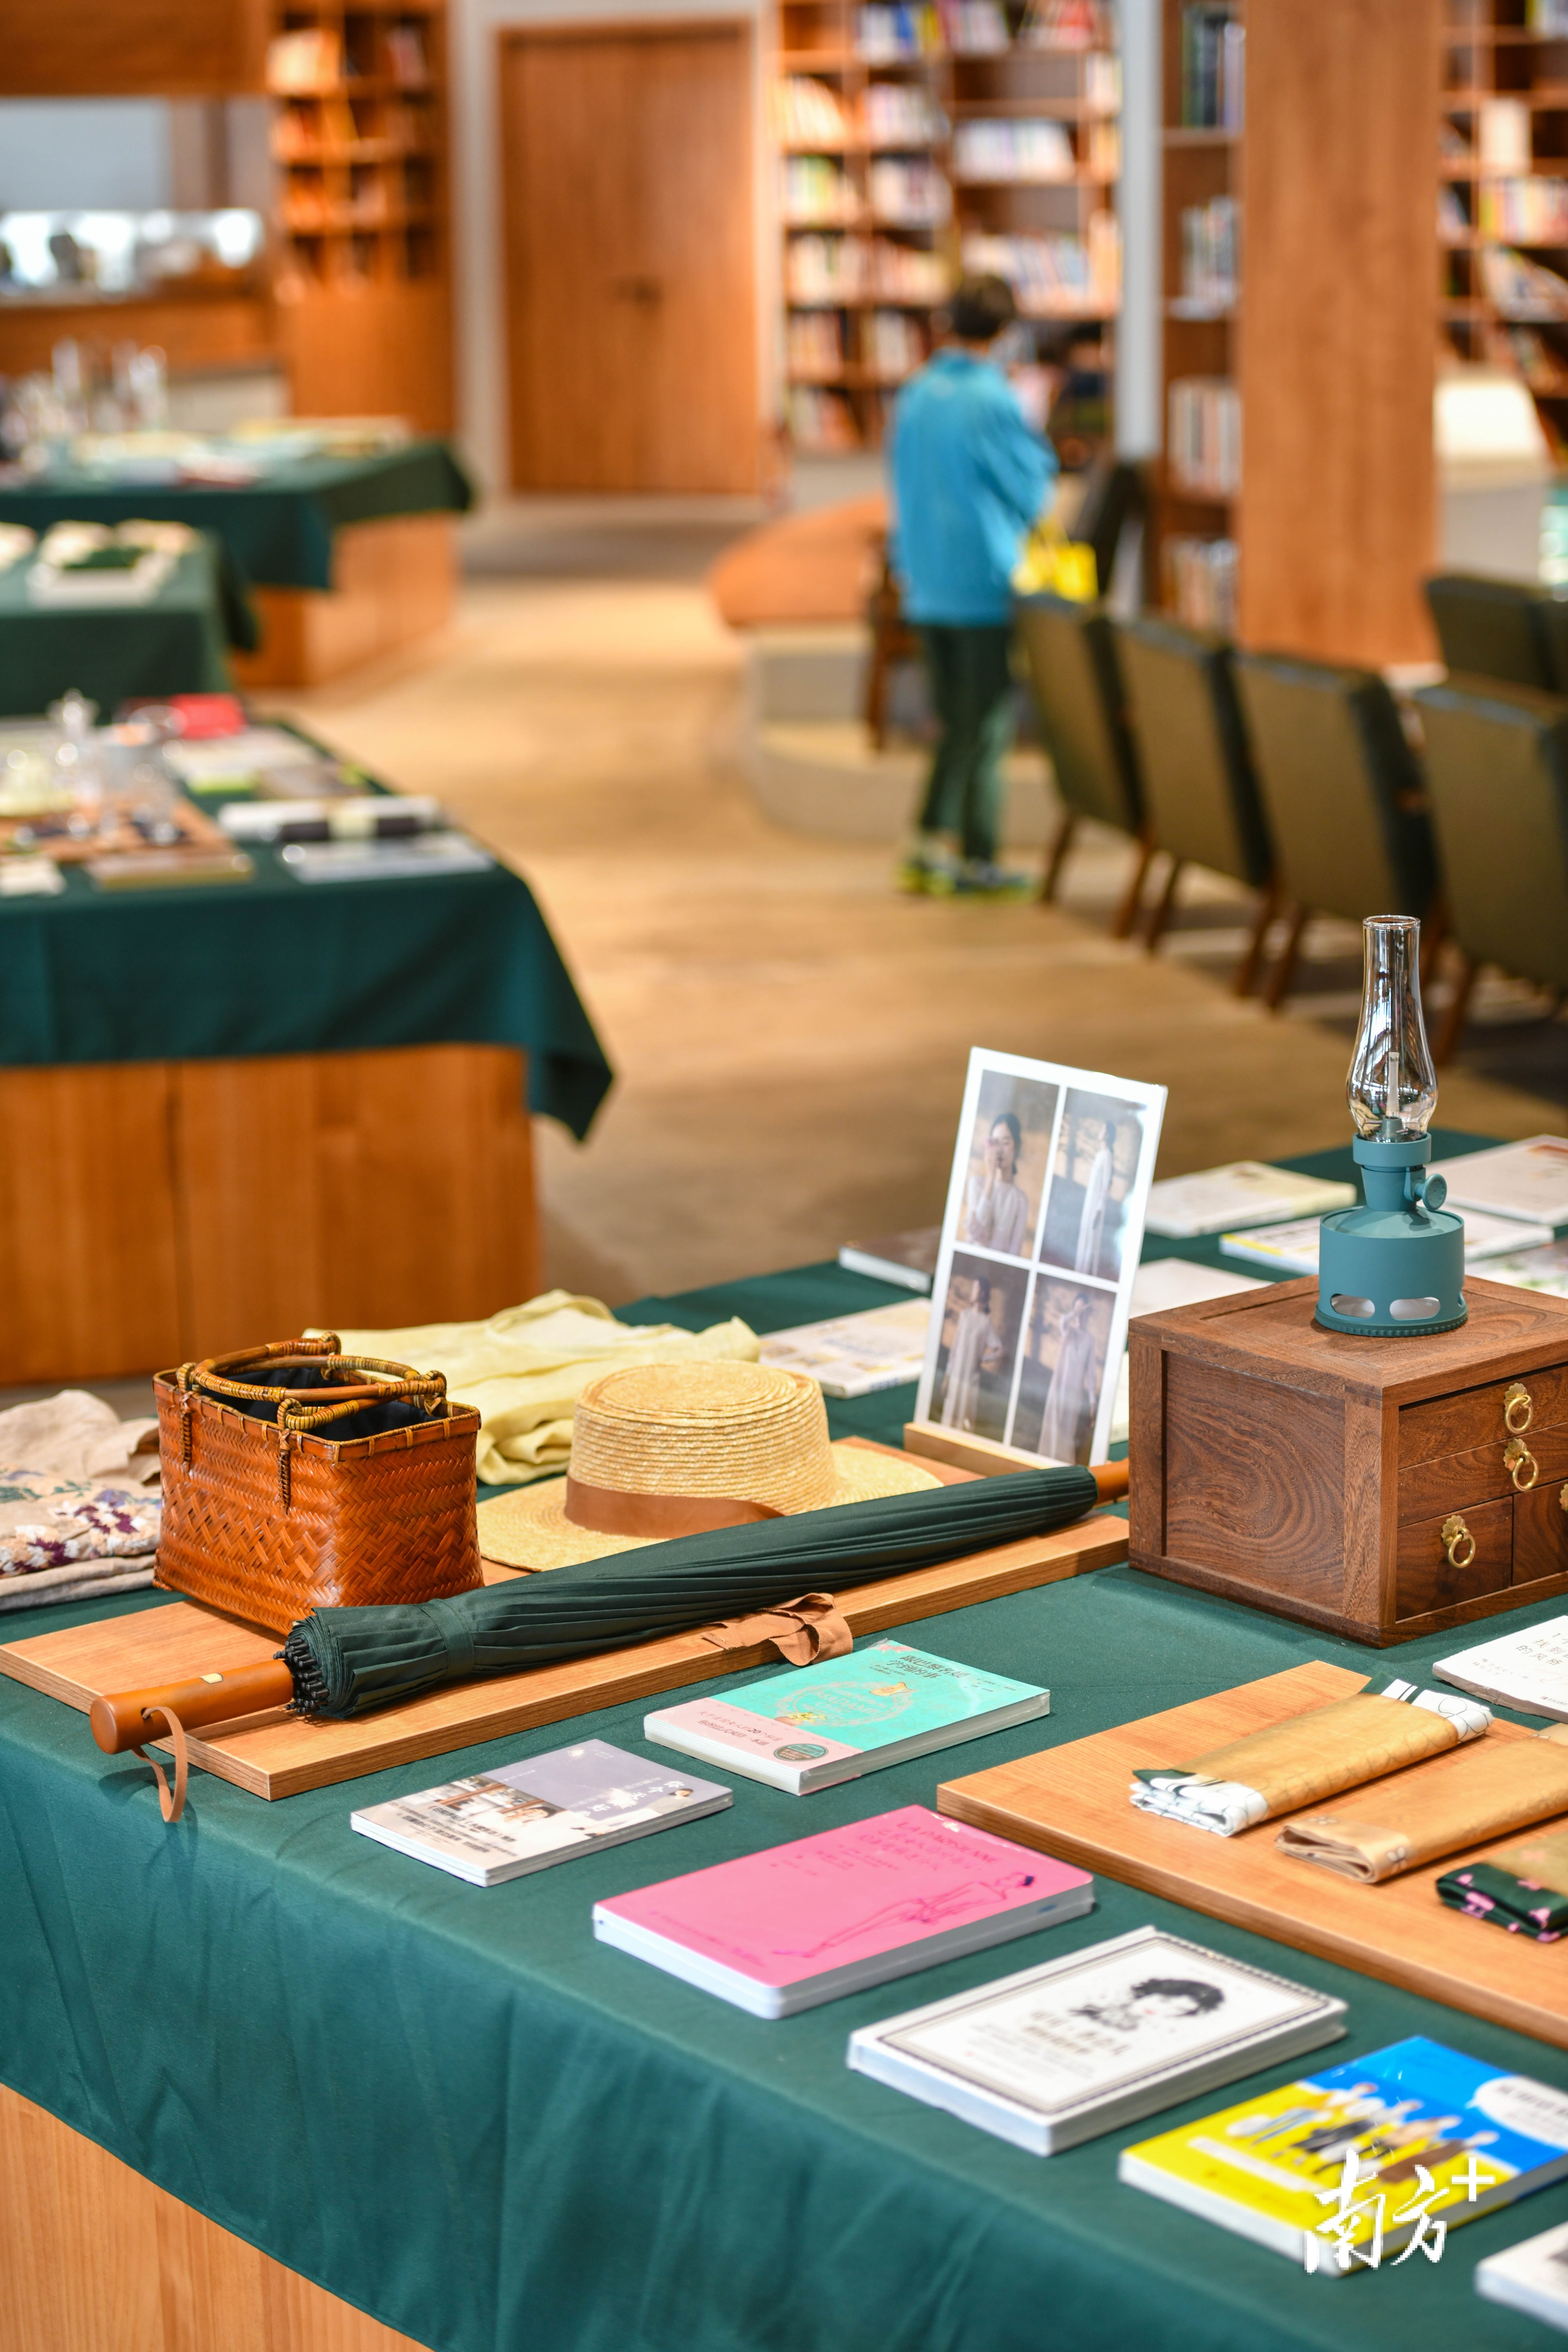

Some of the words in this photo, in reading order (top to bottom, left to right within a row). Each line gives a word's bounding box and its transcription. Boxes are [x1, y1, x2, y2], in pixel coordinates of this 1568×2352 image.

[897, 1655, 972, 1678] 跟巴黎名媛
[1515, 1645, 1563, 1665] 的风格
[881, 1659, 944, 1679] 学到的事
[695, 1711, 786, 1742] 关于法国女人的20个秘密
[696, 1720, 771, 1746] 你的法式风情一本通
[894, 1821, 924, 1833] LA
[916, 1829, 1004, 1865] PARISIENNE
